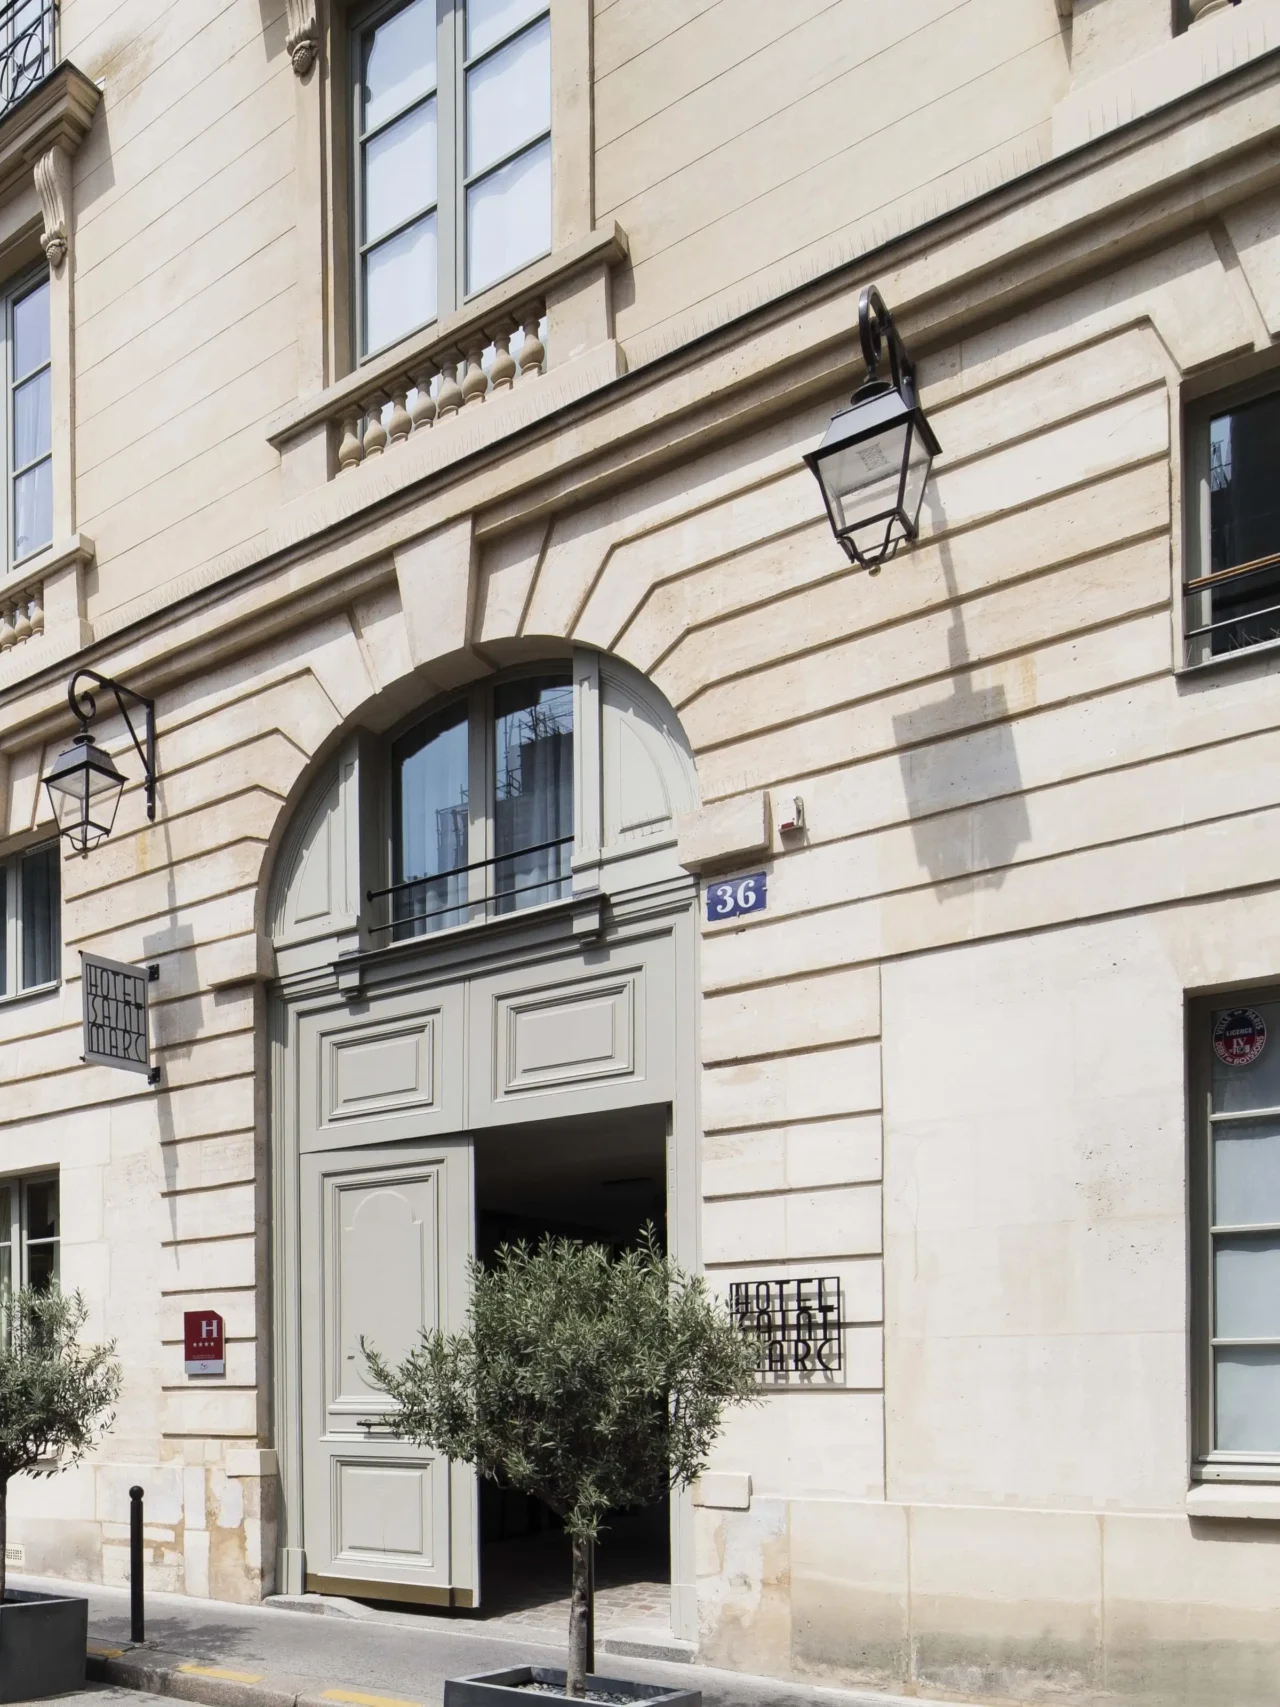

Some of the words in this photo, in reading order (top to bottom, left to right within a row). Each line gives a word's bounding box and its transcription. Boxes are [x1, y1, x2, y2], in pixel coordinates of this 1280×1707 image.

[716, 879, 757, 914] 36
[88, 964, 143, 1010] HOTEL
[91, 994, 144, 1036] SAINT
[1215, 1015, 1231, 1035] VILLE
[1245, 1010, 1264, 1030] PARIS
[1226, 1027, 1253, 1037] LICENCE
[90, 1023, 147, 1064] MARC
[1233, 1035, 1265, 1064] BOISSONS
[733, 1278, 835, 1313] HOTEL
[201, 1319, 218, 1339] H
[756, 1338, 840, 1372] ARC
